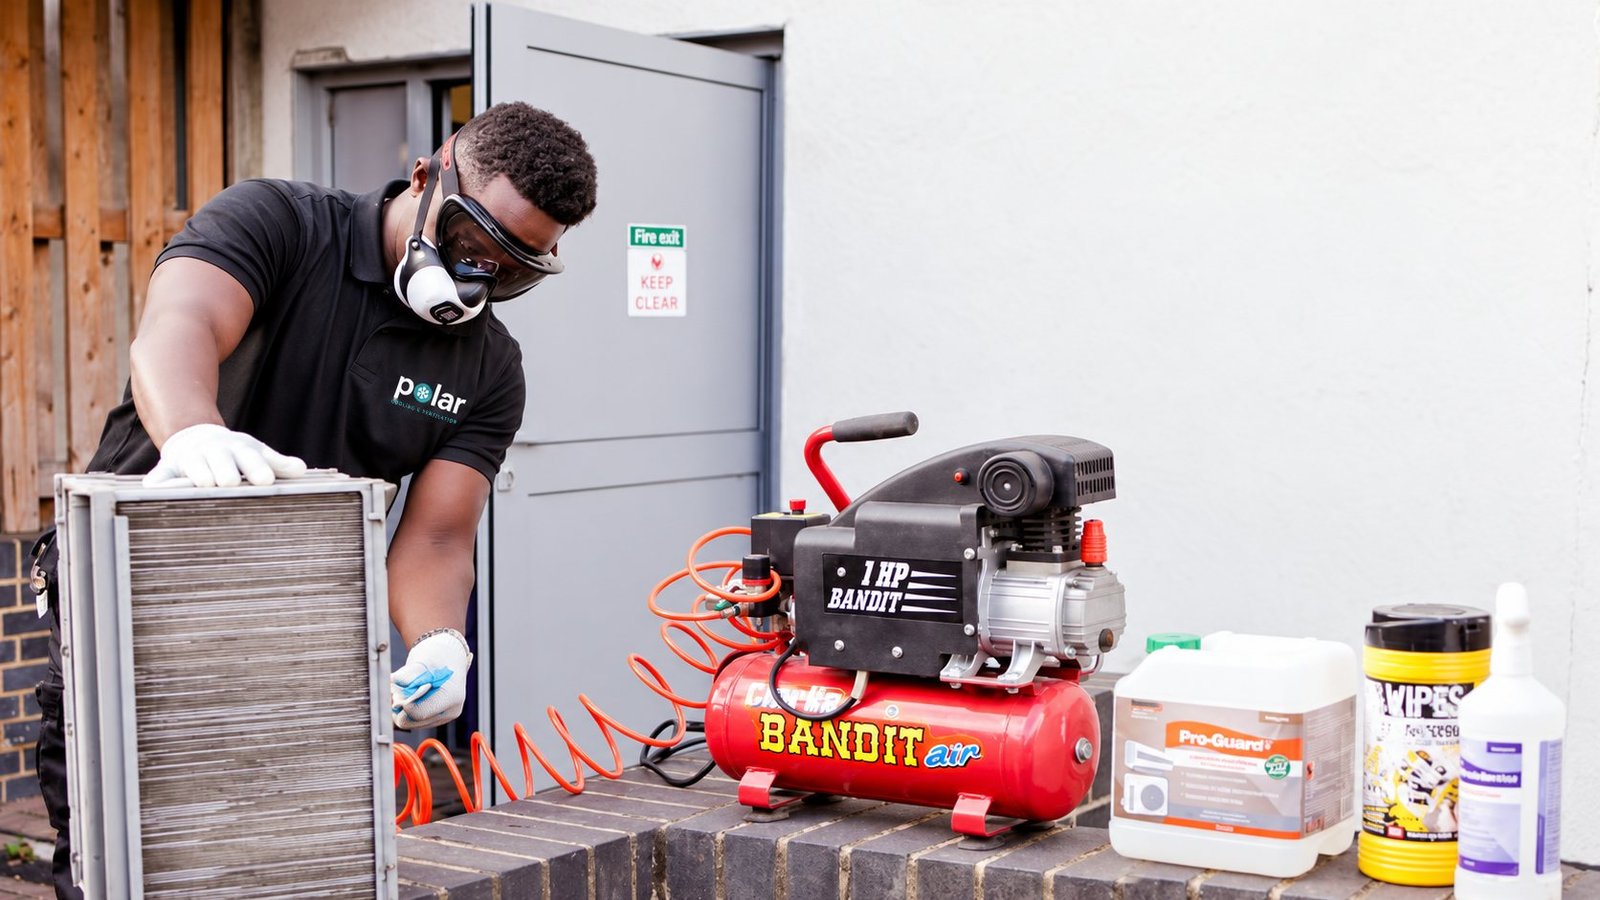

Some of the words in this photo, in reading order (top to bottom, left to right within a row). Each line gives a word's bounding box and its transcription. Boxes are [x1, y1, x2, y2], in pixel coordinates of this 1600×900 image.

[634, 228, 657, 245] Fire
[658, 229, 681, 246] exit
[640, 275, 673, 290] KEEP
[635, 295, 679, 310] CLEAR
[393, 375, 467, 415] polar
[860, 560, 875, 587] 1
[875, 561, 910, 589] HP
[827, 587, 903, 613] BANDIT
[1383, 681, 1465, 719] WIPES
[759, 712, 924, 768] BANDIT
[924, 742, 983, 769] air
[1179, 728, 1265, 753] Pro-Guard
